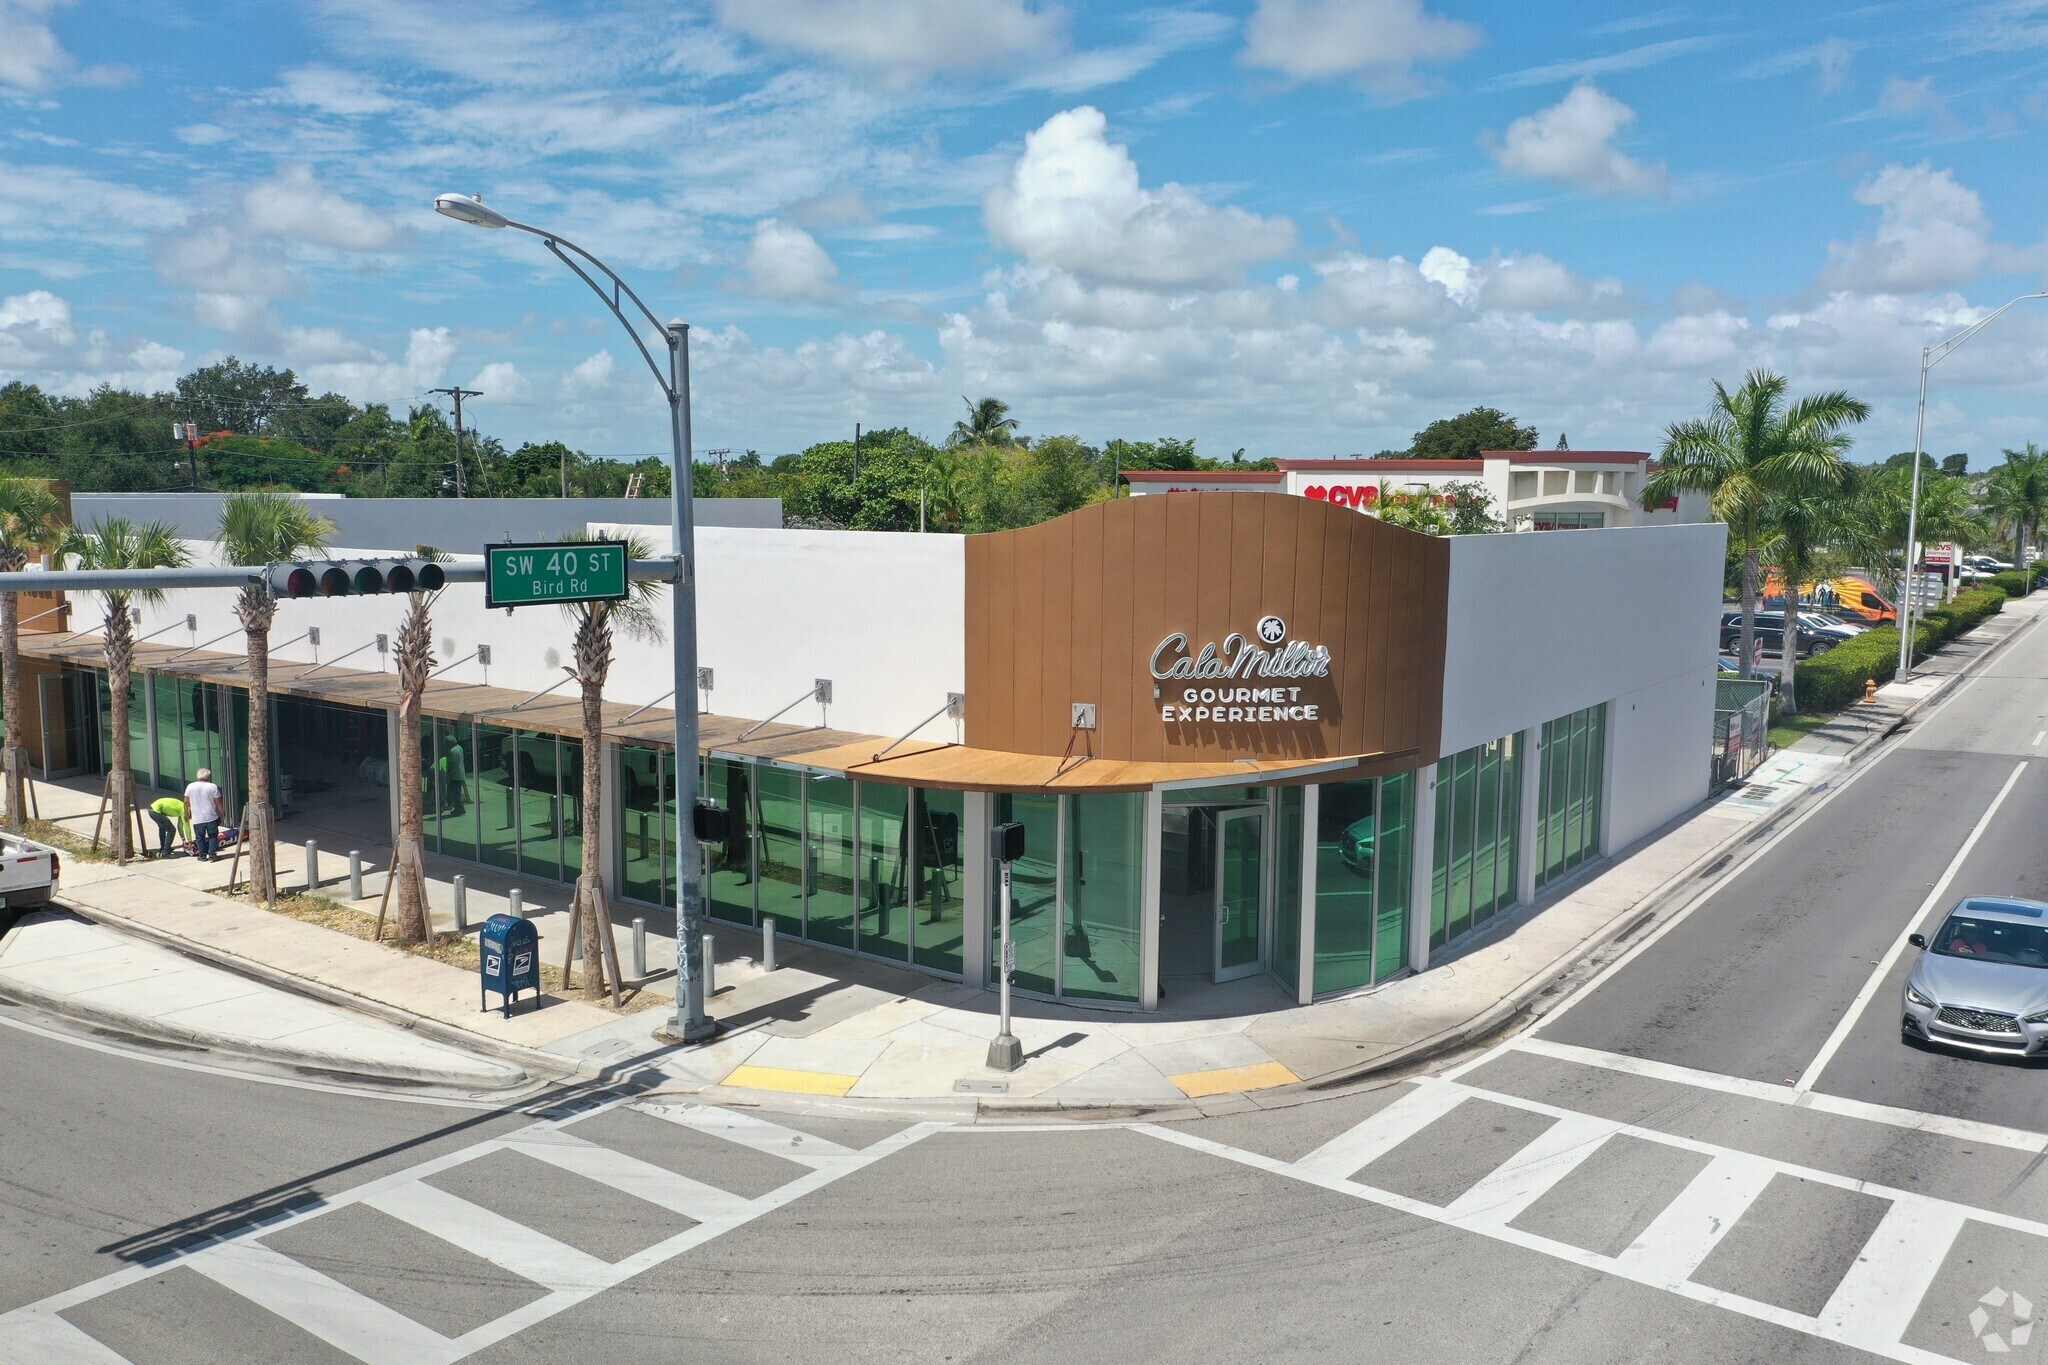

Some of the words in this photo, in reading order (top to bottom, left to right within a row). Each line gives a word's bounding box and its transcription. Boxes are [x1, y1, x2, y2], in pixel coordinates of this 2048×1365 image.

[1329, 485, 1378, 507] CVS
[505, 555, 534, 576] SW
[546, 551, 578, 576] 40
[589, 552, 611, 573] ST
[532, 580, 564, 595] Bird
[570, 578, 588, 593] Rd
[1150, 632, 1229, 680] Cala
[1183, 687, 1301, 704] GOURMET
[1162, 705, 1319, 723] EXPERIENCE
